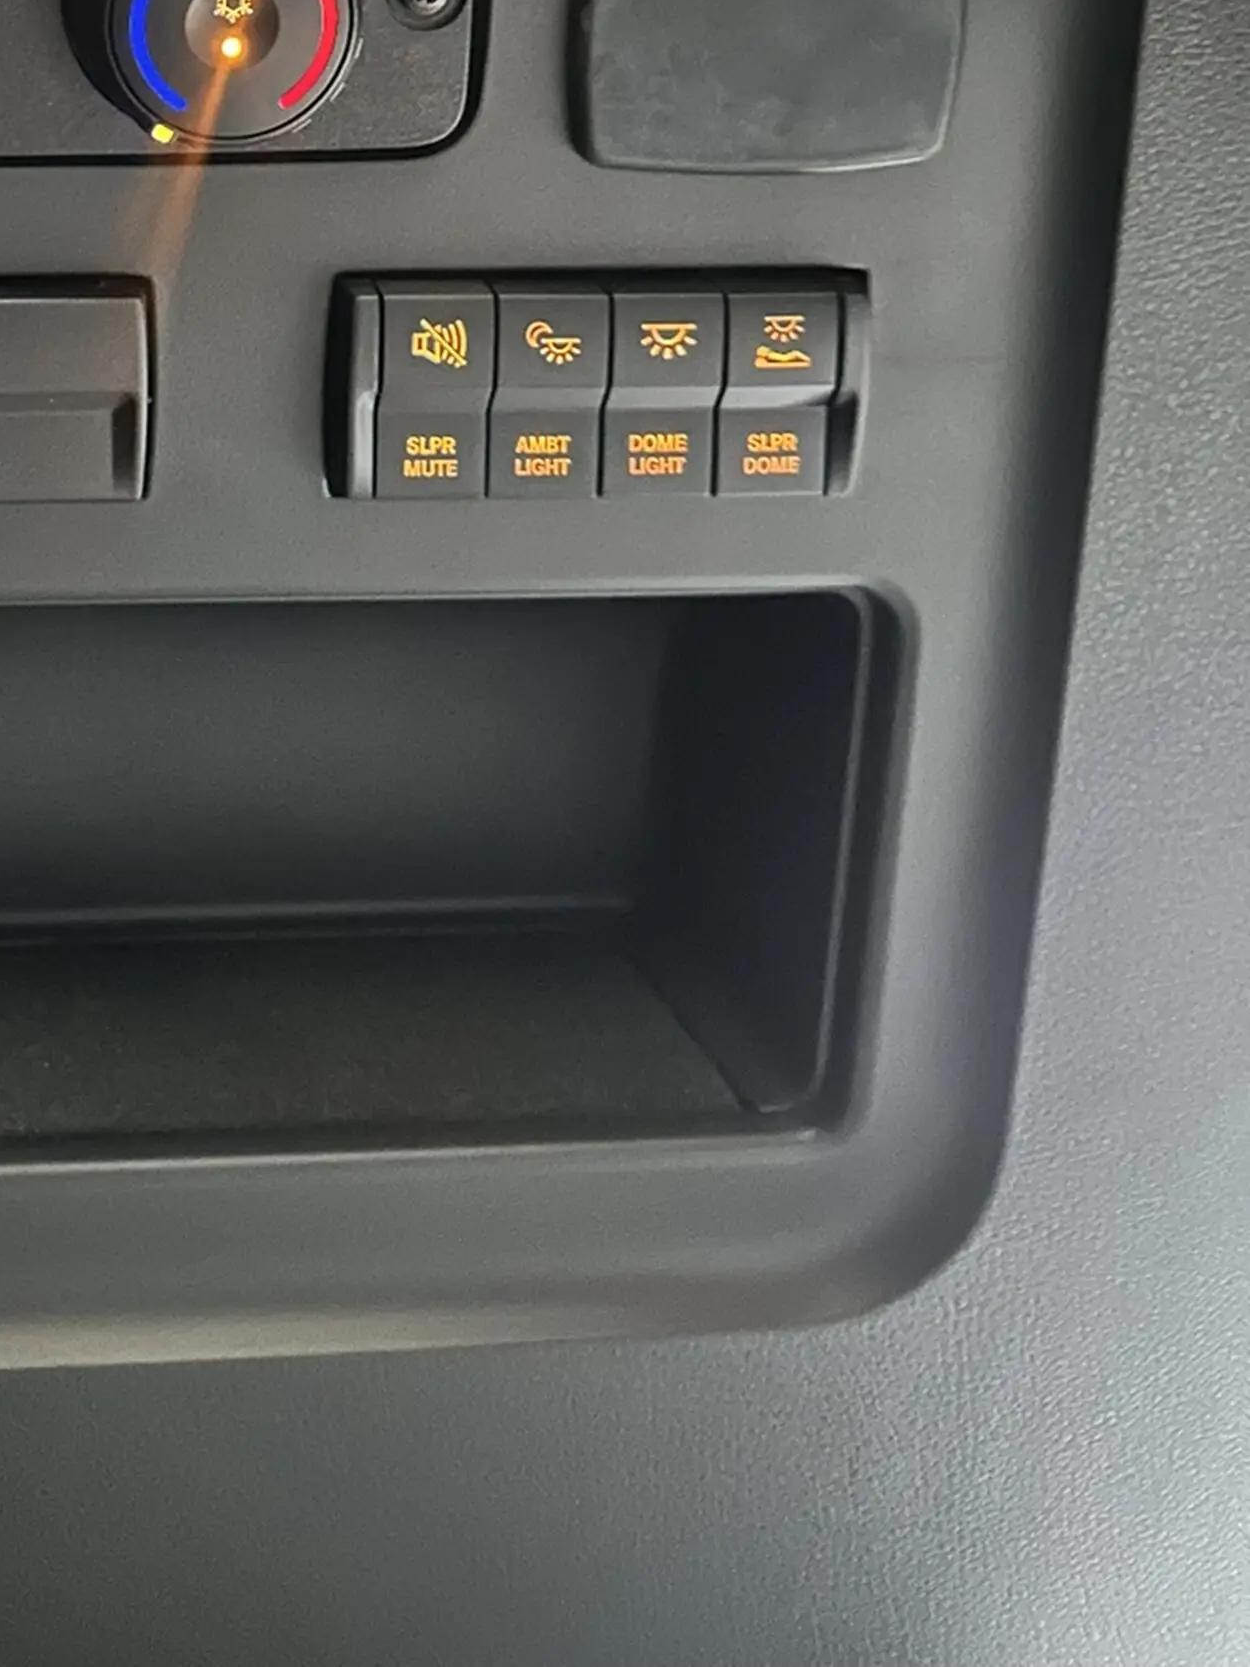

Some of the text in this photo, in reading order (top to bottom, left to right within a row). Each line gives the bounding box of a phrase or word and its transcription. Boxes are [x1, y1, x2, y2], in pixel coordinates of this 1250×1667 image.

[406, 436, 456, 455] SLPR
[514, 435, 572, 453] AMBT
[628, 433, 688, 452] DOME
[746, 433, 799, 452] SLPR
[403, 459, 459, 478] MUTE
[514, 457, 572, 477] LIGHT
[629, 456, 687, 475] LIGHT
[743, 455, 802, 475] DOME
